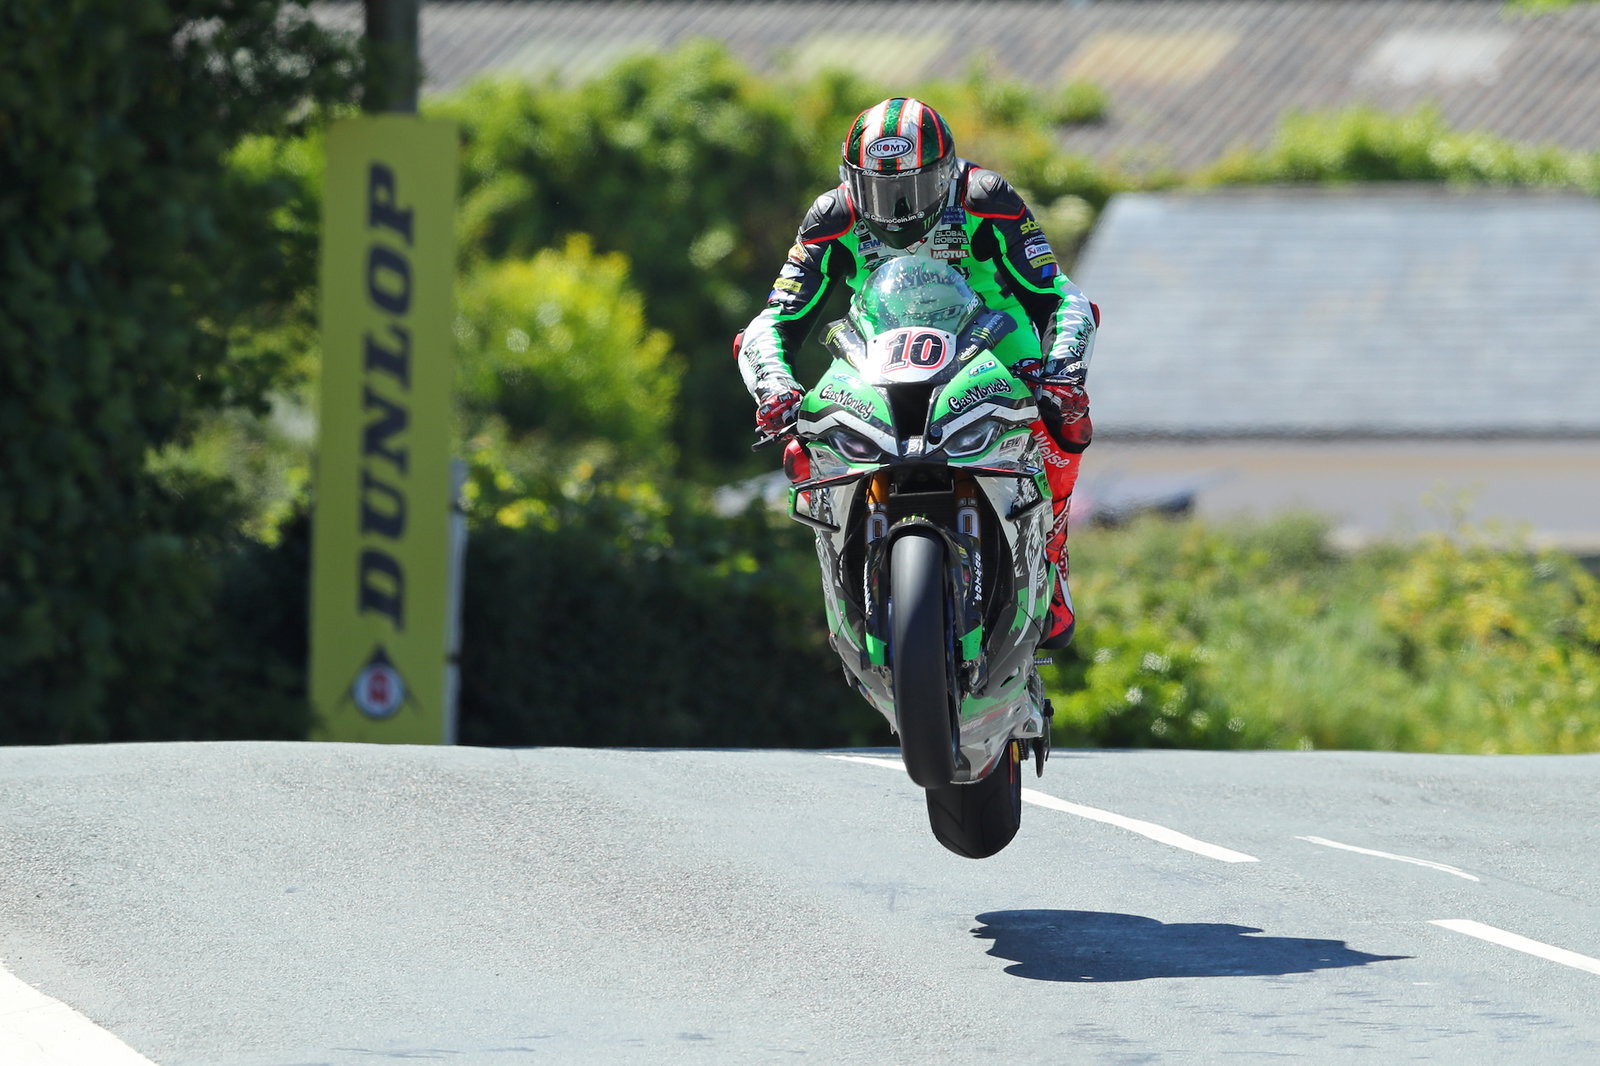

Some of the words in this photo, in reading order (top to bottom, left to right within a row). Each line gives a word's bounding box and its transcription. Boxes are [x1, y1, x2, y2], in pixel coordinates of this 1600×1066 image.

[871, 143, 907, 152] SUOMY
[935, 230, 966, 238] GLOBAL
[932, 250, 968, 259] MOTUL
[881, 330, 947, 374] 10
[357, 161, 413, 635] DUNLOP
[819, 383, 876, 421] GasMonkey
[948, 377, 1013, 414] GasMonkey
[1032, 430, 1071, 469] Weise
